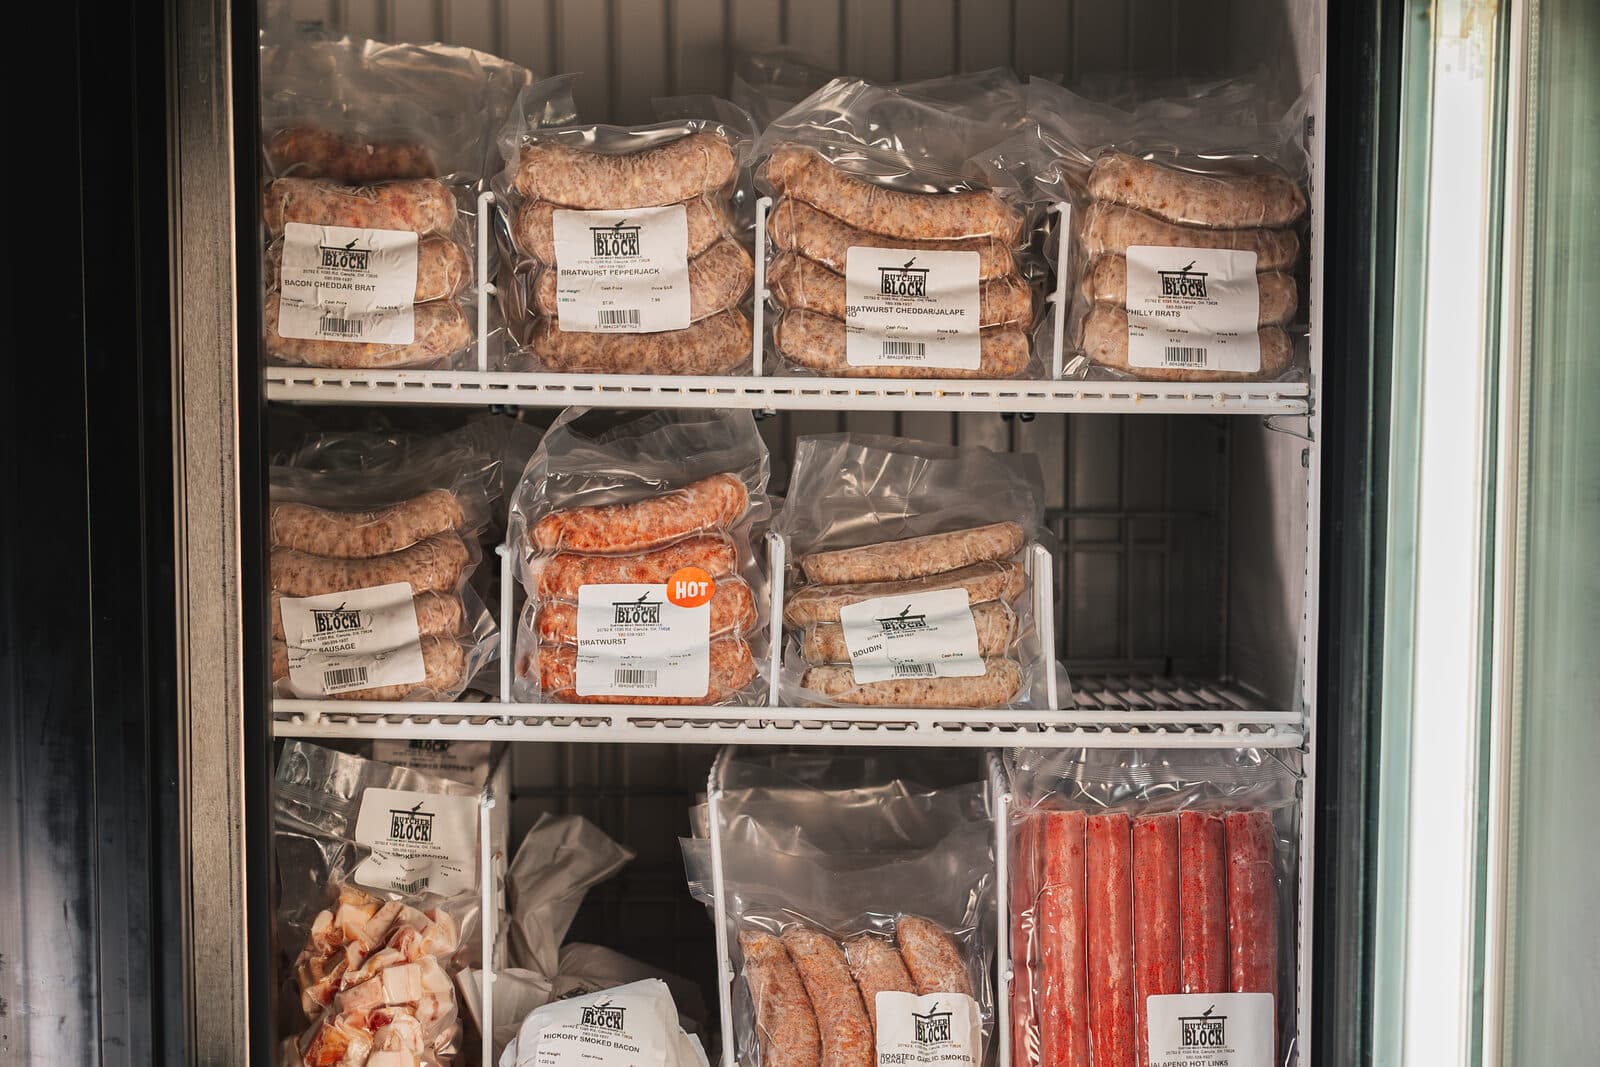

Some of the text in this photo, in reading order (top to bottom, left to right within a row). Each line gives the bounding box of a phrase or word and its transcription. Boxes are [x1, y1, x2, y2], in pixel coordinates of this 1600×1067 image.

[597, 239, 637, 256] BLOCK
[325, 254, 365, 269] BLOCK
[884, 274, 924, 282] BUTCHER
[314, 281, 352, 290] CHEDDAR
[355, 284, 376, 292] BRAT
[884, 281, 923, 296] BLOCK
[1165, 282, 1204, 297] BLOCK
[1126, 309, 1153, 317] PHILLY
[675, 581, 708, 600] HOT
[317, 615, 358, 632] BLOCK
[618, 611, 656, 623] BLOCK
[319, 643, 356, 653] SAUSAGE
[580, 638, 627, 646] BRATWURST
[853, 644, 882, 658] BOUDIN
[394, 816, 430, 826] BUTCHER
[393, 822, 429, 841] BLOCK
[585, 1014, 621, 1030] BLOCK
[1184, 1023, 1222, 1031] BUTCHER
[918, 1025, 948, 1043] BLOCK
[1184, 1029, 1222, 1046] BLOCK
[543, 1032, 640, 1053] HICKORY SMOKED BACON
[940, 1054, 971, 1062] SMOKED
